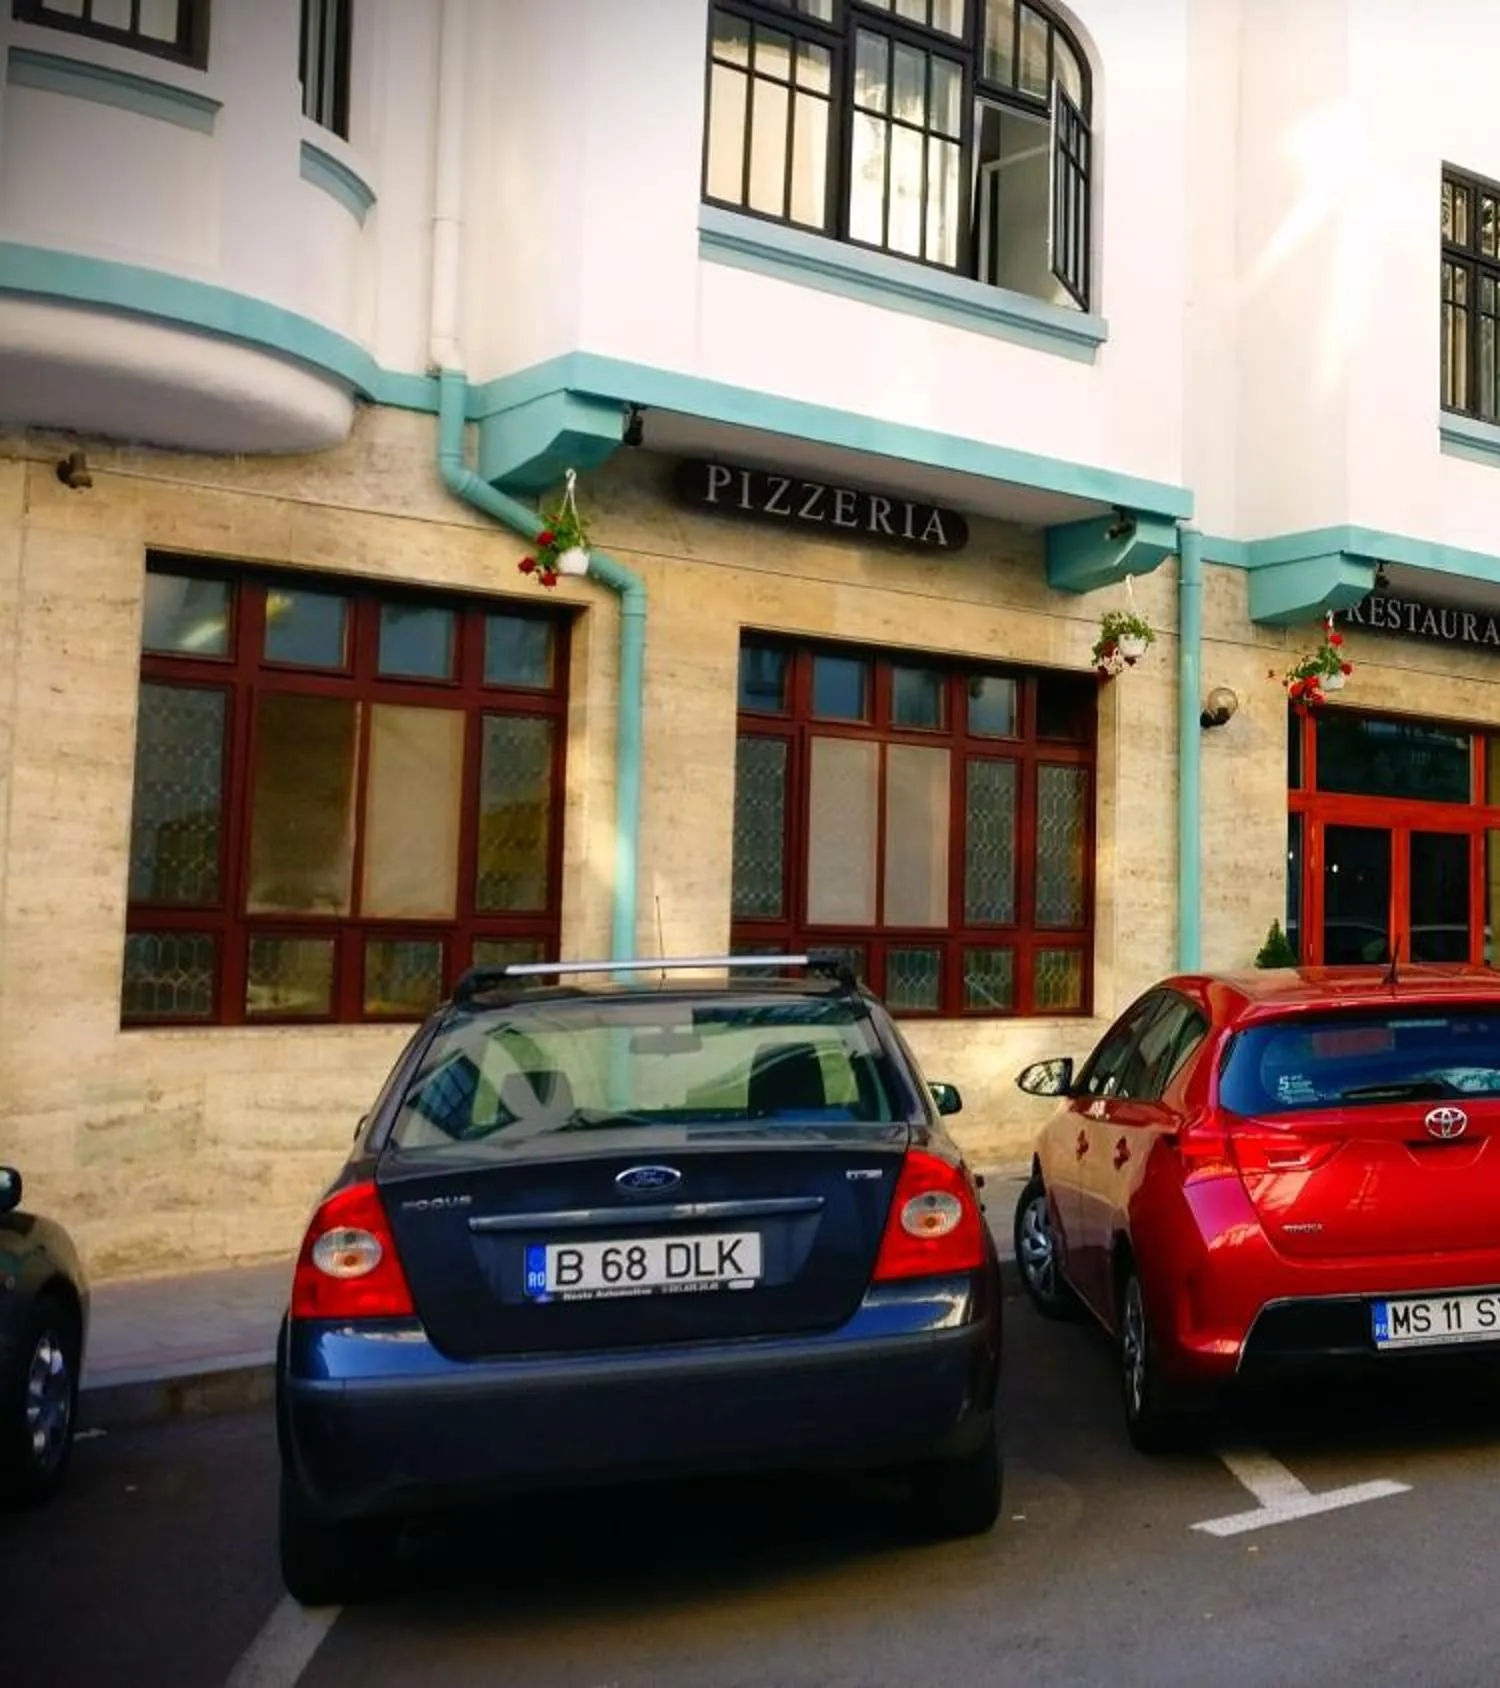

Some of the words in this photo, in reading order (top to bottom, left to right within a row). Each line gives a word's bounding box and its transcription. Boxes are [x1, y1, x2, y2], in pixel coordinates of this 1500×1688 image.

[704, 463, 949, 546] PIZZERIA
[555, 1249, 584, 1286] B
[601, 1245, 648, 1283] 68
[665, 1239, 744, 1279] DLK
[1391, 1303, 1431, 1336] MS
[1442, 1300, 1463, 1331] 11
